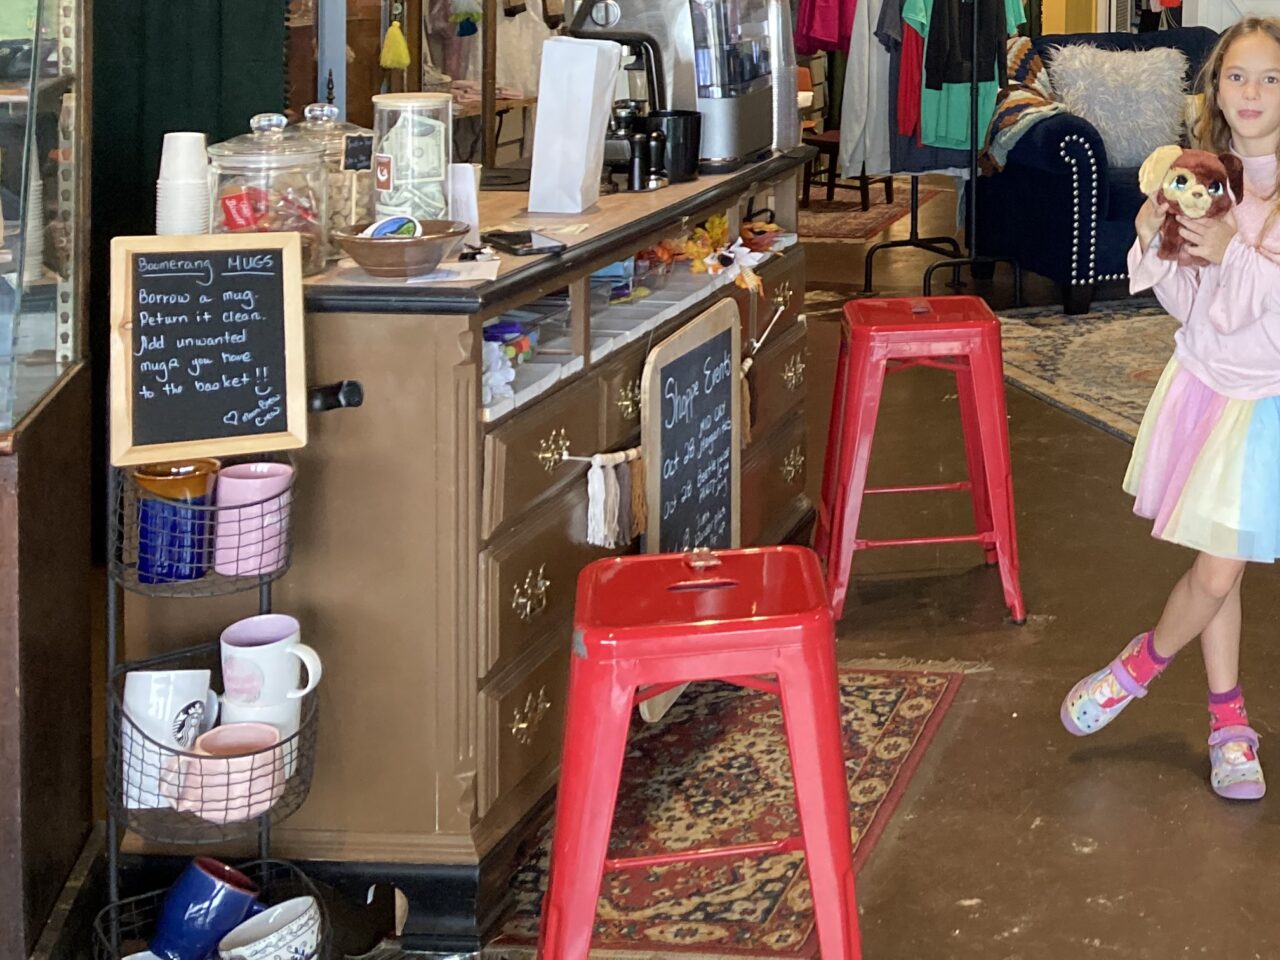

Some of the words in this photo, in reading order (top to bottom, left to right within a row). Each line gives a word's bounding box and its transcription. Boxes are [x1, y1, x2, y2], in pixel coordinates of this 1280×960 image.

[138, 257, 213, 286] Boomerang
[227, 254, 273, 270] MUGS
[139, 288, 190, 304] Borrow
[199, 294, 213, 303] a
[140, 311, 188, 327] Return
[196, 311, 212, 322] it
[133, 334, 164, 356] Add
[176, 328, 247, 348] unwanted
[140, 358, 179, 382] mugs
[187, 358, 213, 376] you
[221, 351, 252, 363] have
[139, 385, 154, 399] to
[162, 383, 183, 396] the
[664, 376, 699, 428] Shoppe
[703, 350, 731, 394] Events
[663, 448, 679, 479] Oct
